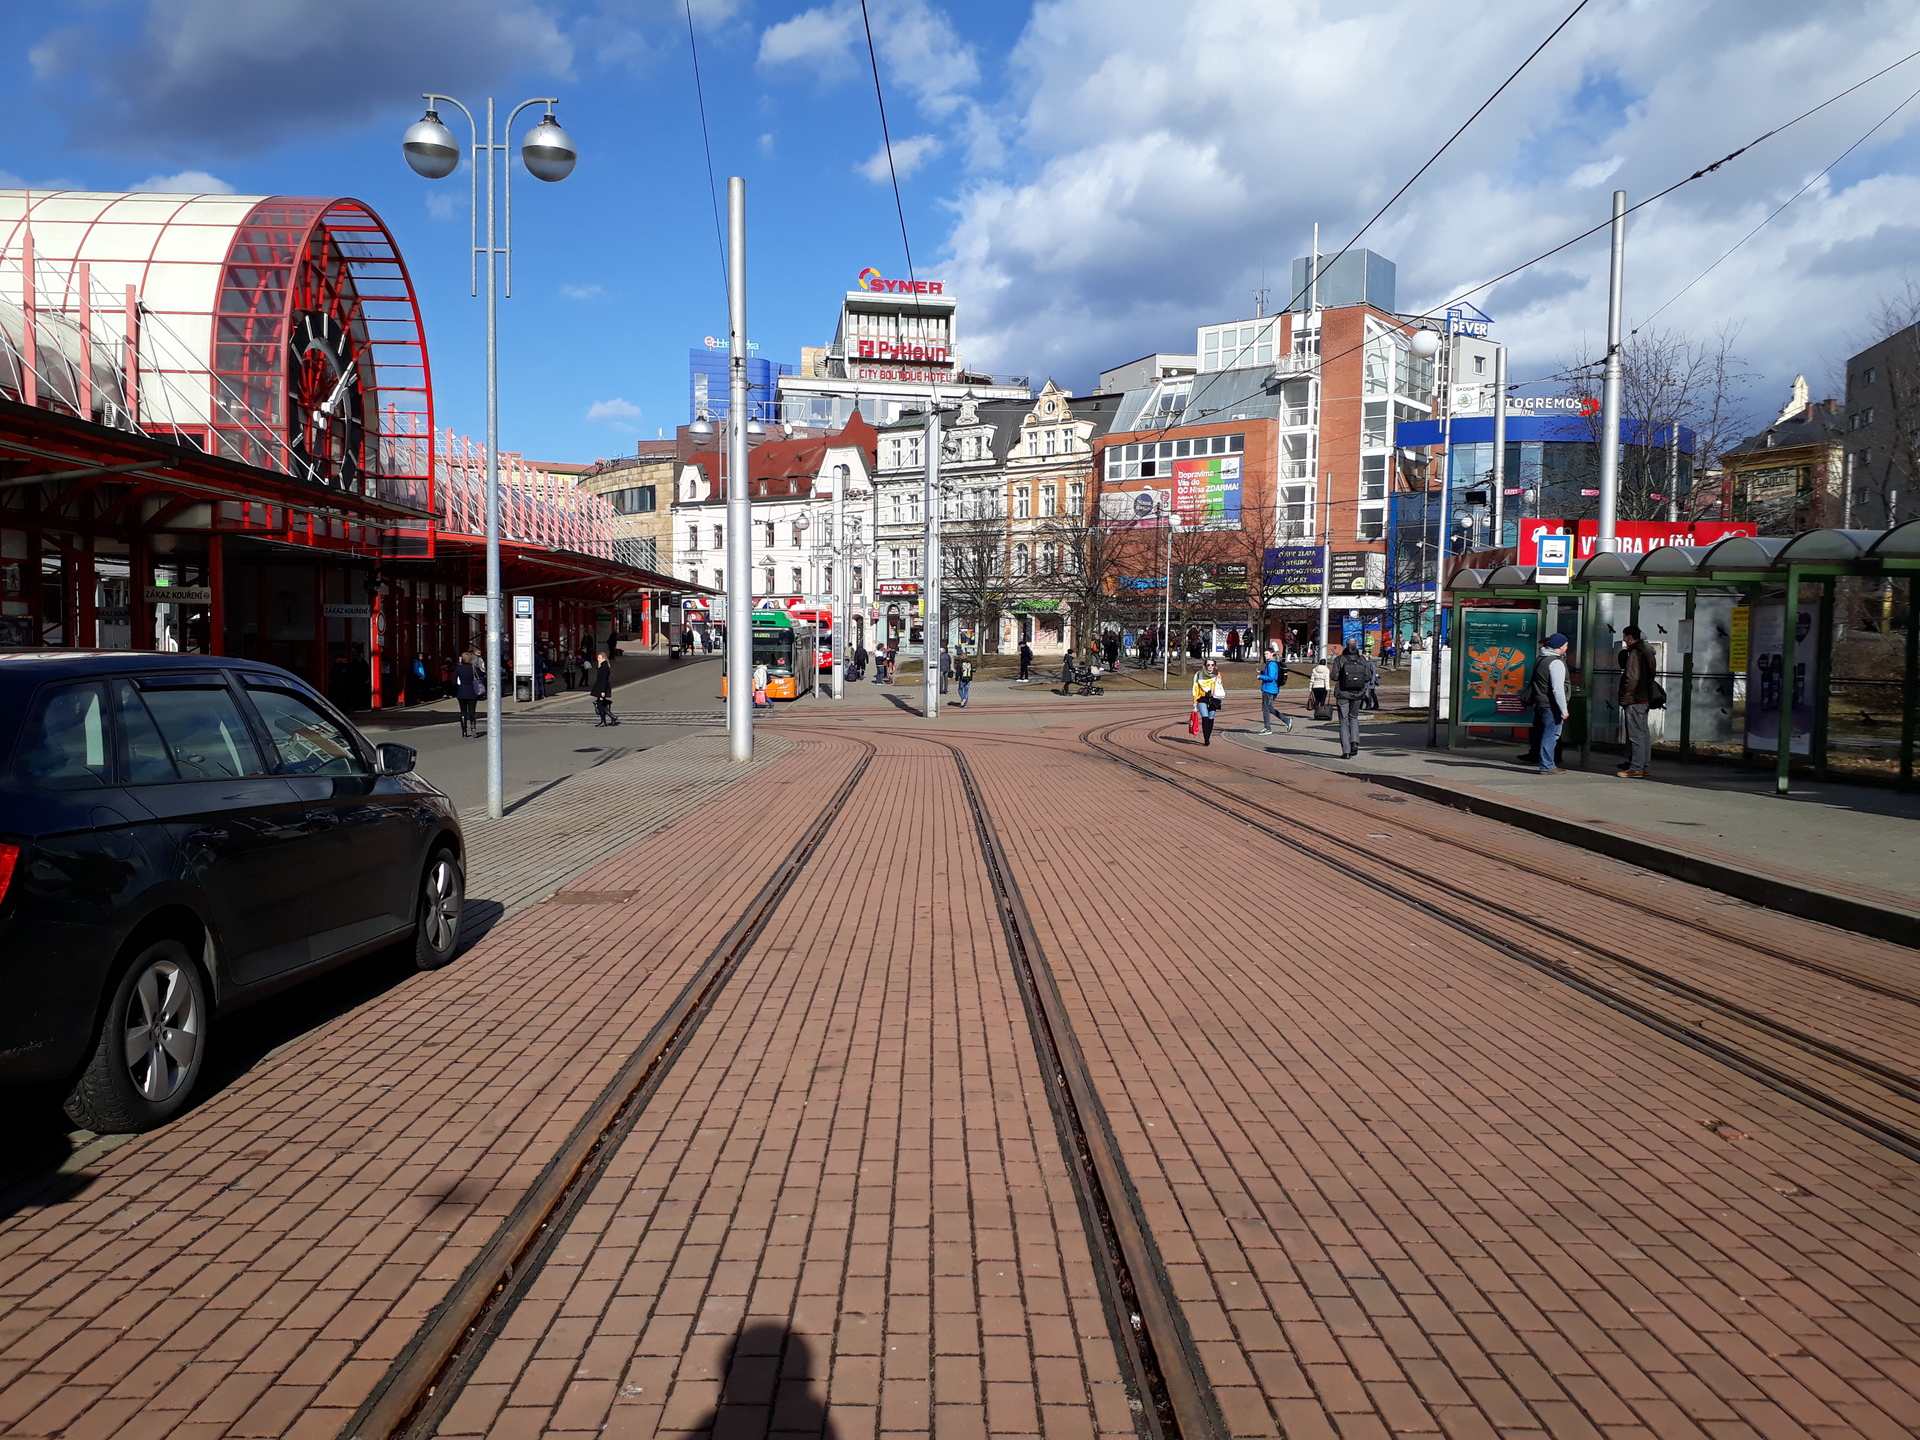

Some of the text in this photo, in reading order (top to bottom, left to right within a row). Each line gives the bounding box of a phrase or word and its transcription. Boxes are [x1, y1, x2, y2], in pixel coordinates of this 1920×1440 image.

[870, 278, 943, 295] SYNER
[879, 341, 947, 360] Pytloun
[860, 369, 951, 382] CITY BOUTIQUE HOTEL
[1482, 397, 1582, 409] ATOGREMOS
[1177, 486, 1188, 494] OC
[1206, 483, 1239, 492] ZDARMA!
[145, 588, 203, 600] ZÁKAZ KOUŘENÍ
